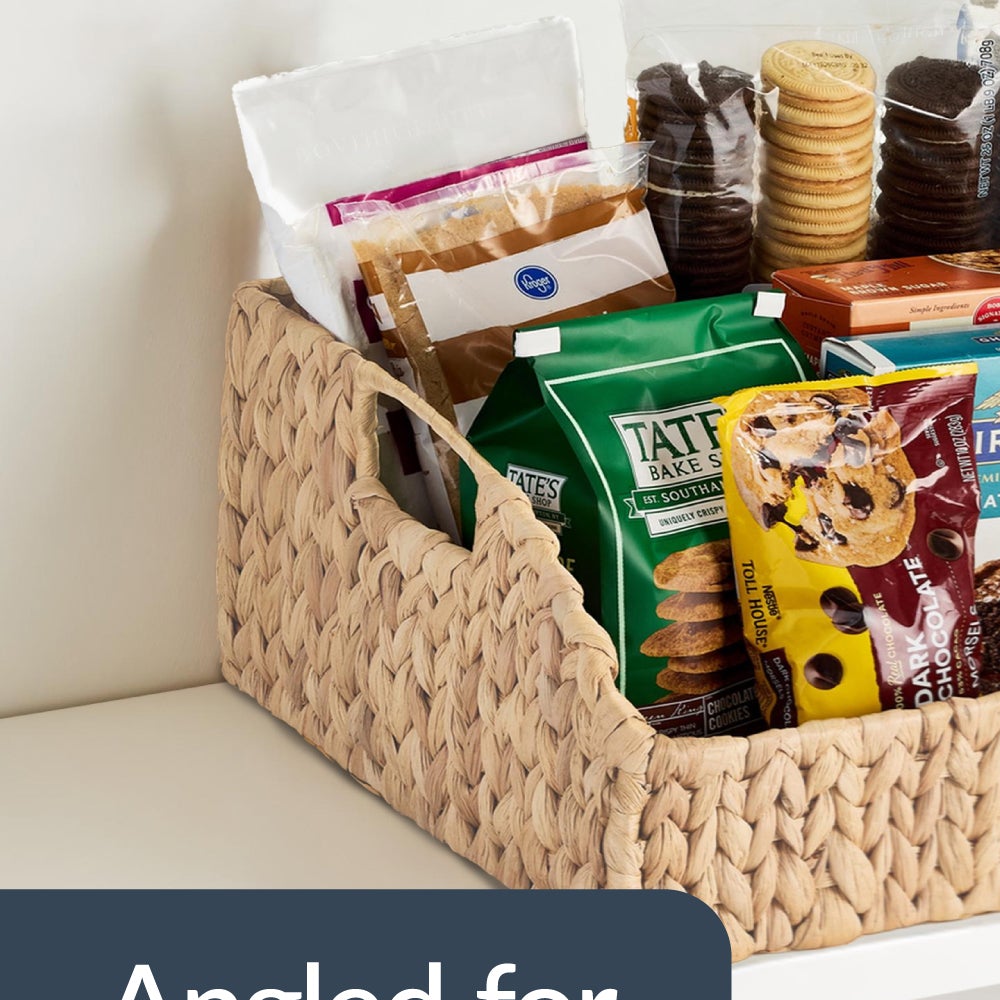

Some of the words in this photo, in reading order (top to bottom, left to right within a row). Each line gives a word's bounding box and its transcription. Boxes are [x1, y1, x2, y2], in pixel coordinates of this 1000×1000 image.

[978, 39, 995, 66] 708g
[980, 125, 994, 141] OZ
[977, 157, 991, 176] WT
[976, 176, 991, 199] NET
[521, 274, 551, 293] Kroger
[901, 281, 949, 291] SUGAR
[909, 305, 932, 315] Simple
[933, 302, 970, 312] Ingredients
[621, 408, 724, 462] TATE
[952, 435, 970, 448] OZ
[648, 458, 703, 481] BAKE
[957, 455, 973, 469] WT
[509, 470, 560, 500] TATE'S
[960, 468, 976, 483] NET
[532, 496, 552, 507] SHOP
[642, 494, 660, 505] EST.
[661, 480, 723, 503] SOUTHA
[659, 511, 696, 527] UNIQUELY
[696, 505, 725, 519] CRISPY
[742, 560, 758, 595] TOLL
[749, 599, 768, 646] HOUSE
[873, 592, 896, 659] CHOCOLATE
[903, 556, 953, 701] CHOCOLATE
[887, 660, 905, 687] Real
[905, 632, 934, 709] DARK
[707, 687, 755, 716] CHOCOLAT
[773, 657, 790, 681] DARK
[783, 683, 792, 728] CHOCOL
[895, 687, 905, 709] 00%
[709, 705, 752, 731] COOKIES
